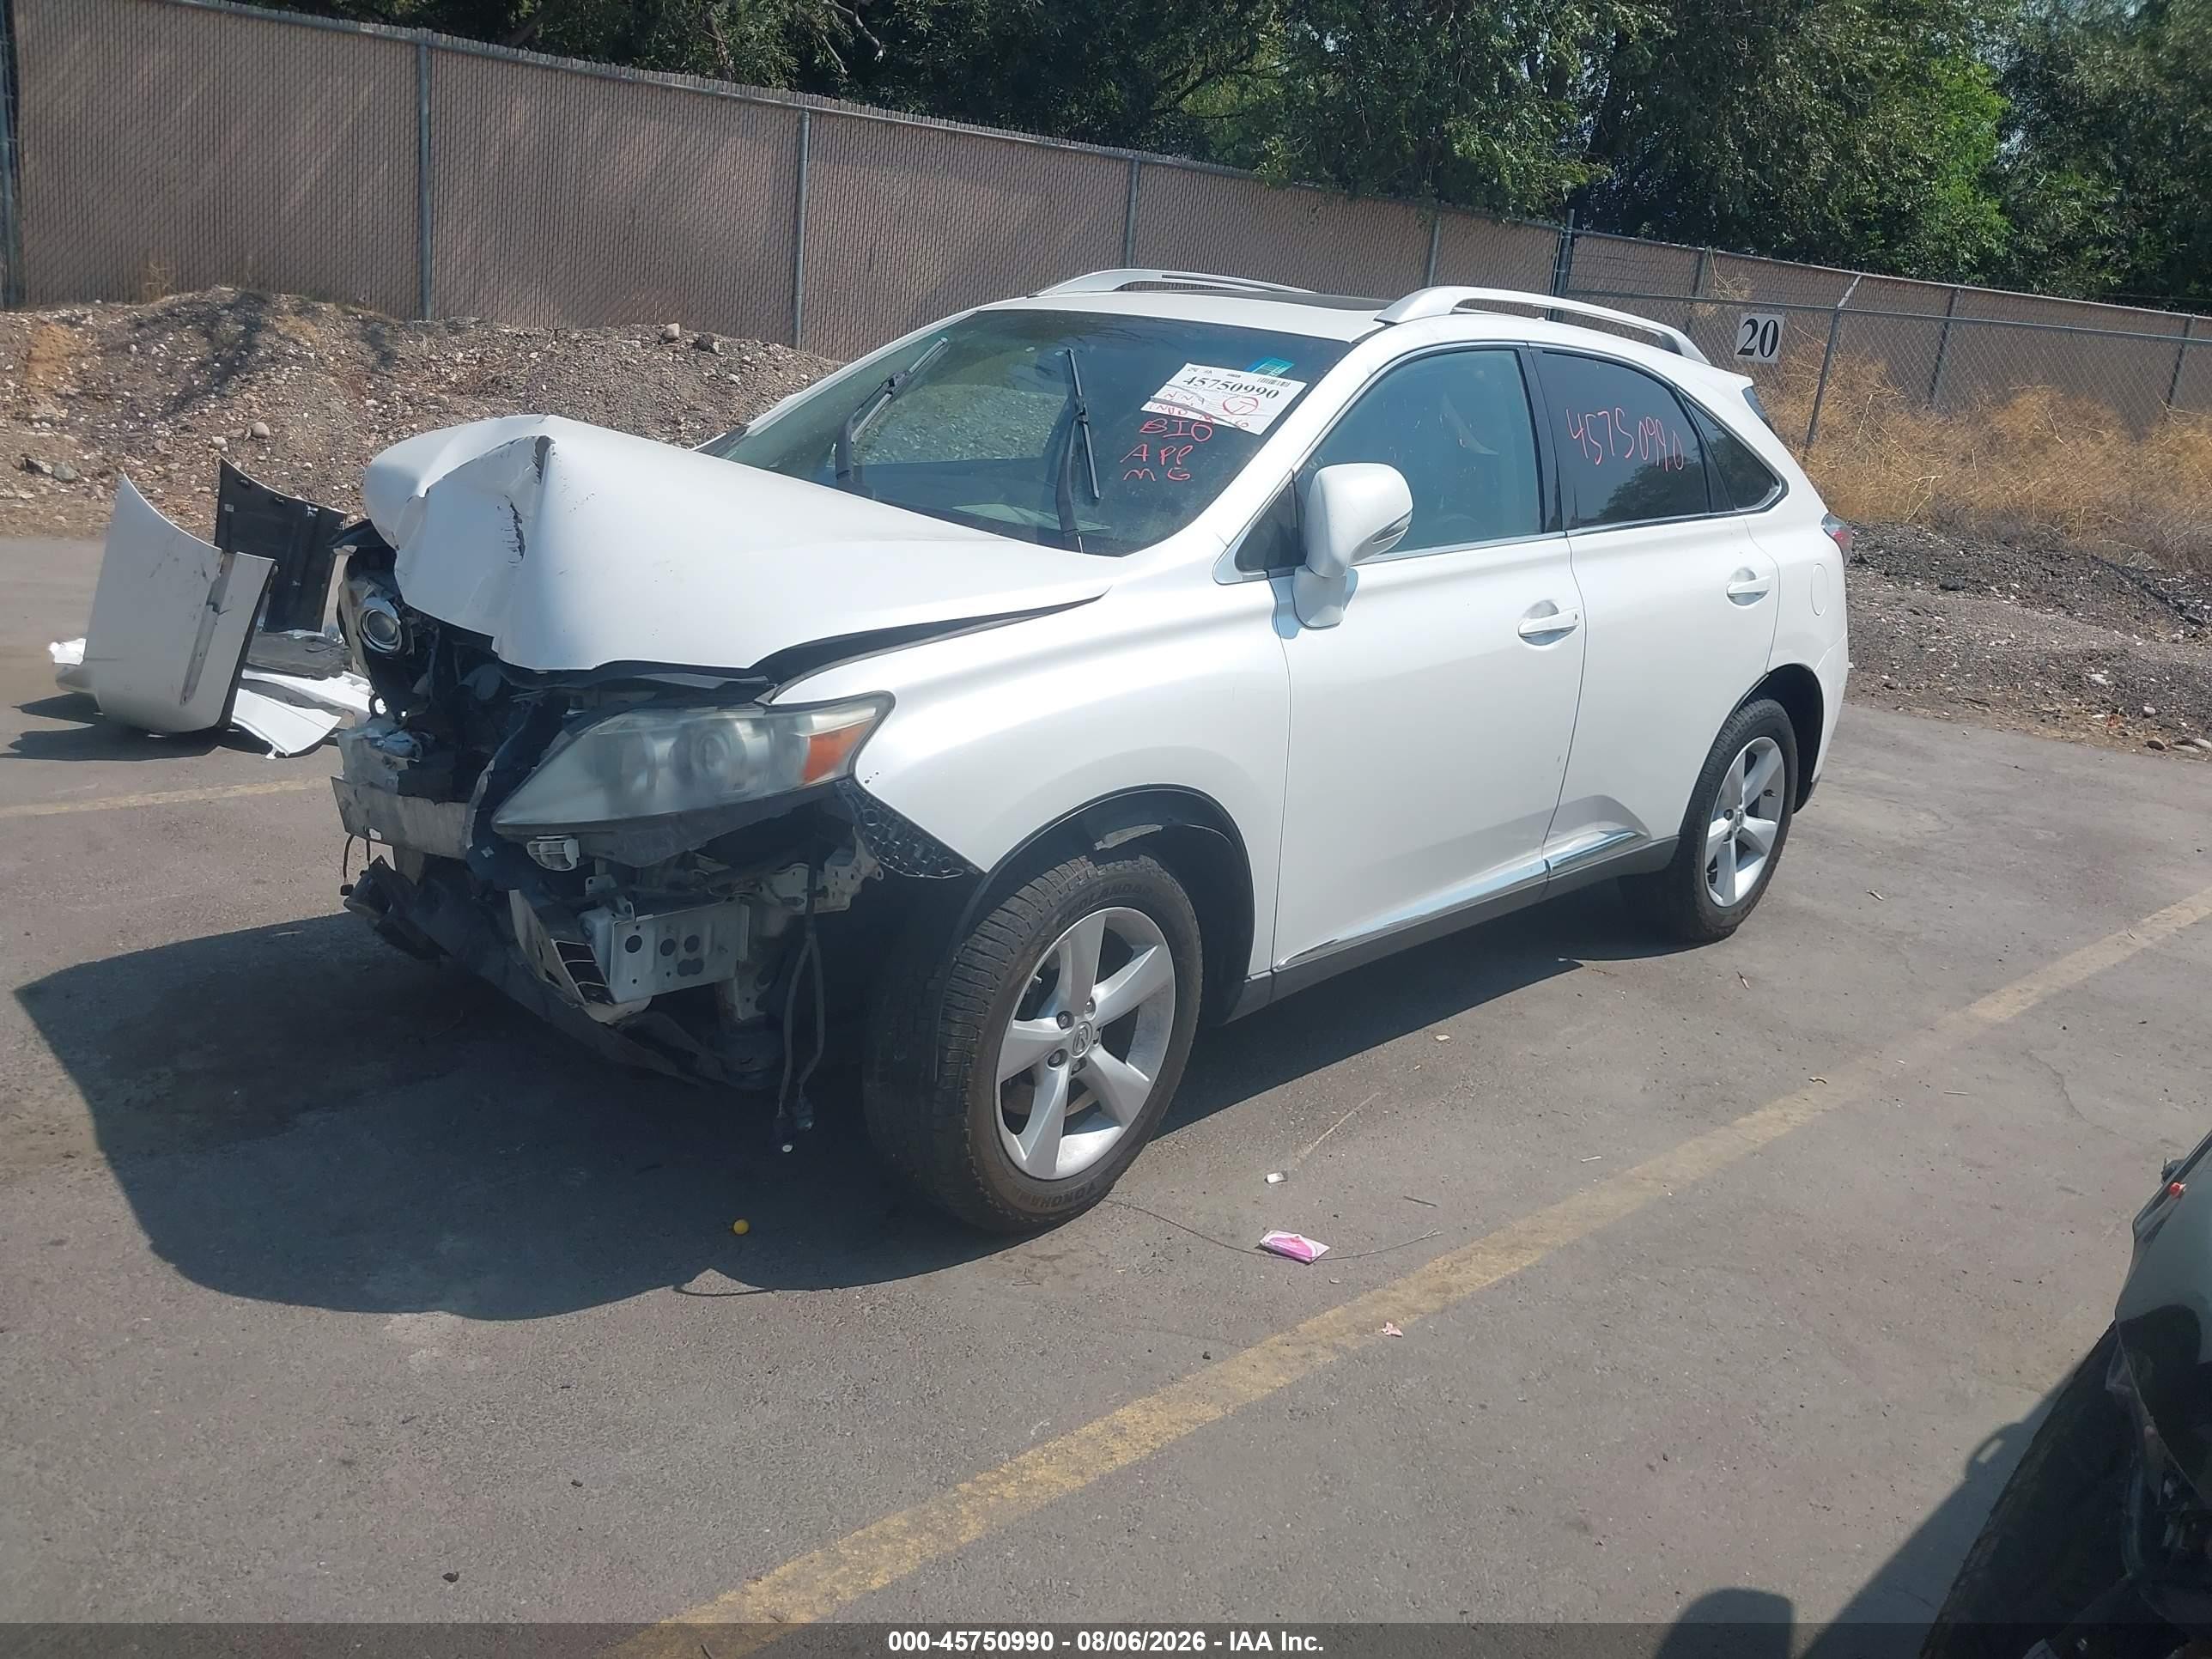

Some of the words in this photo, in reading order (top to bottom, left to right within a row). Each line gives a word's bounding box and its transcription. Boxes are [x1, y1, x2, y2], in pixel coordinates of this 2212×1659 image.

[1736, 319, 1779, 358] 20
[1183, 376, 1279, 399] 45750990
[1139, 418, 1212, 442] BIO
[1565, 406, 1684, 472] 45750990
